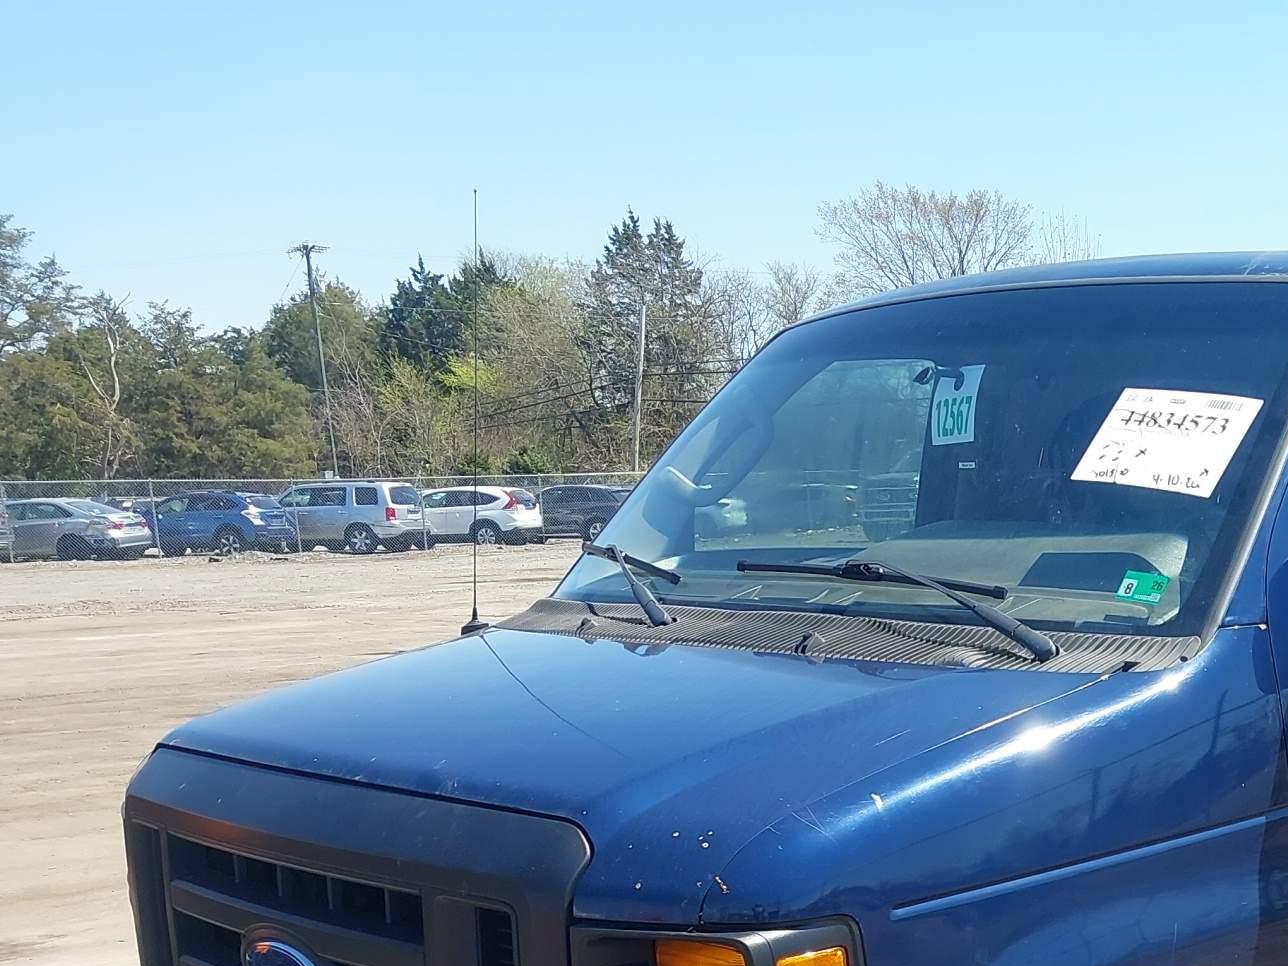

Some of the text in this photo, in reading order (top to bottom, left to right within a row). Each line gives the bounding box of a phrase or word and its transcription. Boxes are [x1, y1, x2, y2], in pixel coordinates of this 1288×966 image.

[935, 395, 973, 438] 12567
[1124, 582, 1134, 595] 8
[1151, 580, 1165, 591] 26
